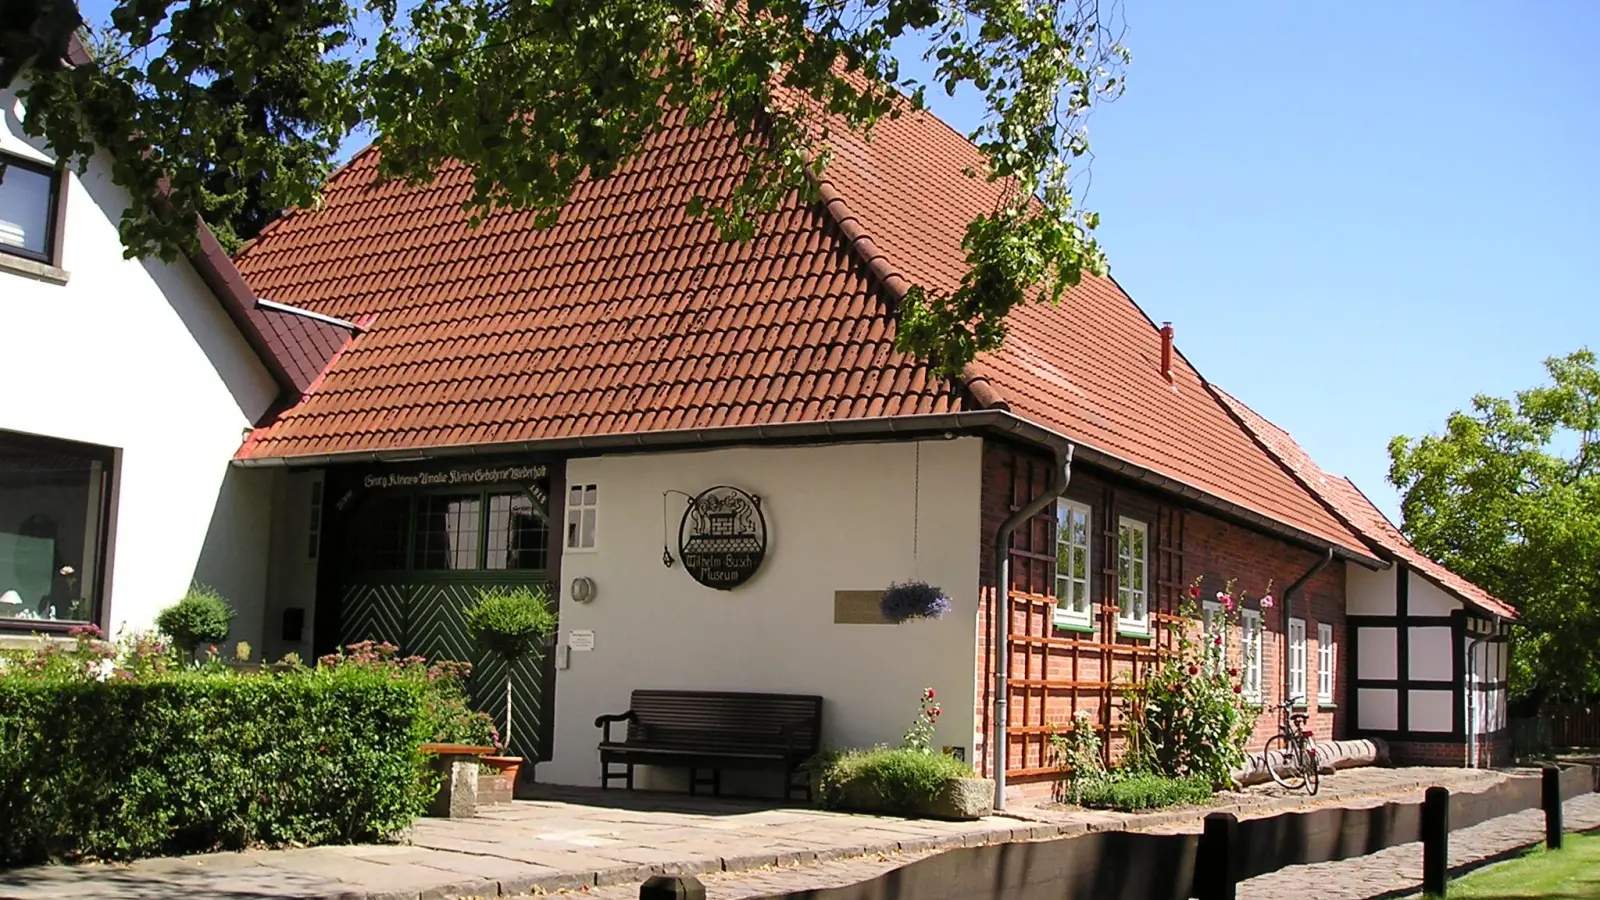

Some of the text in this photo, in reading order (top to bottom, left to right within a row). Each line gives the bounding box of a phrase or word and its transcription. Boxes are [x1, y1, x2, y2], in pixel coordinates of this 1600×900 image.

[686, 553, 753, 568] Wilhelm Busch
[700, 567, 739, 581] Museum
